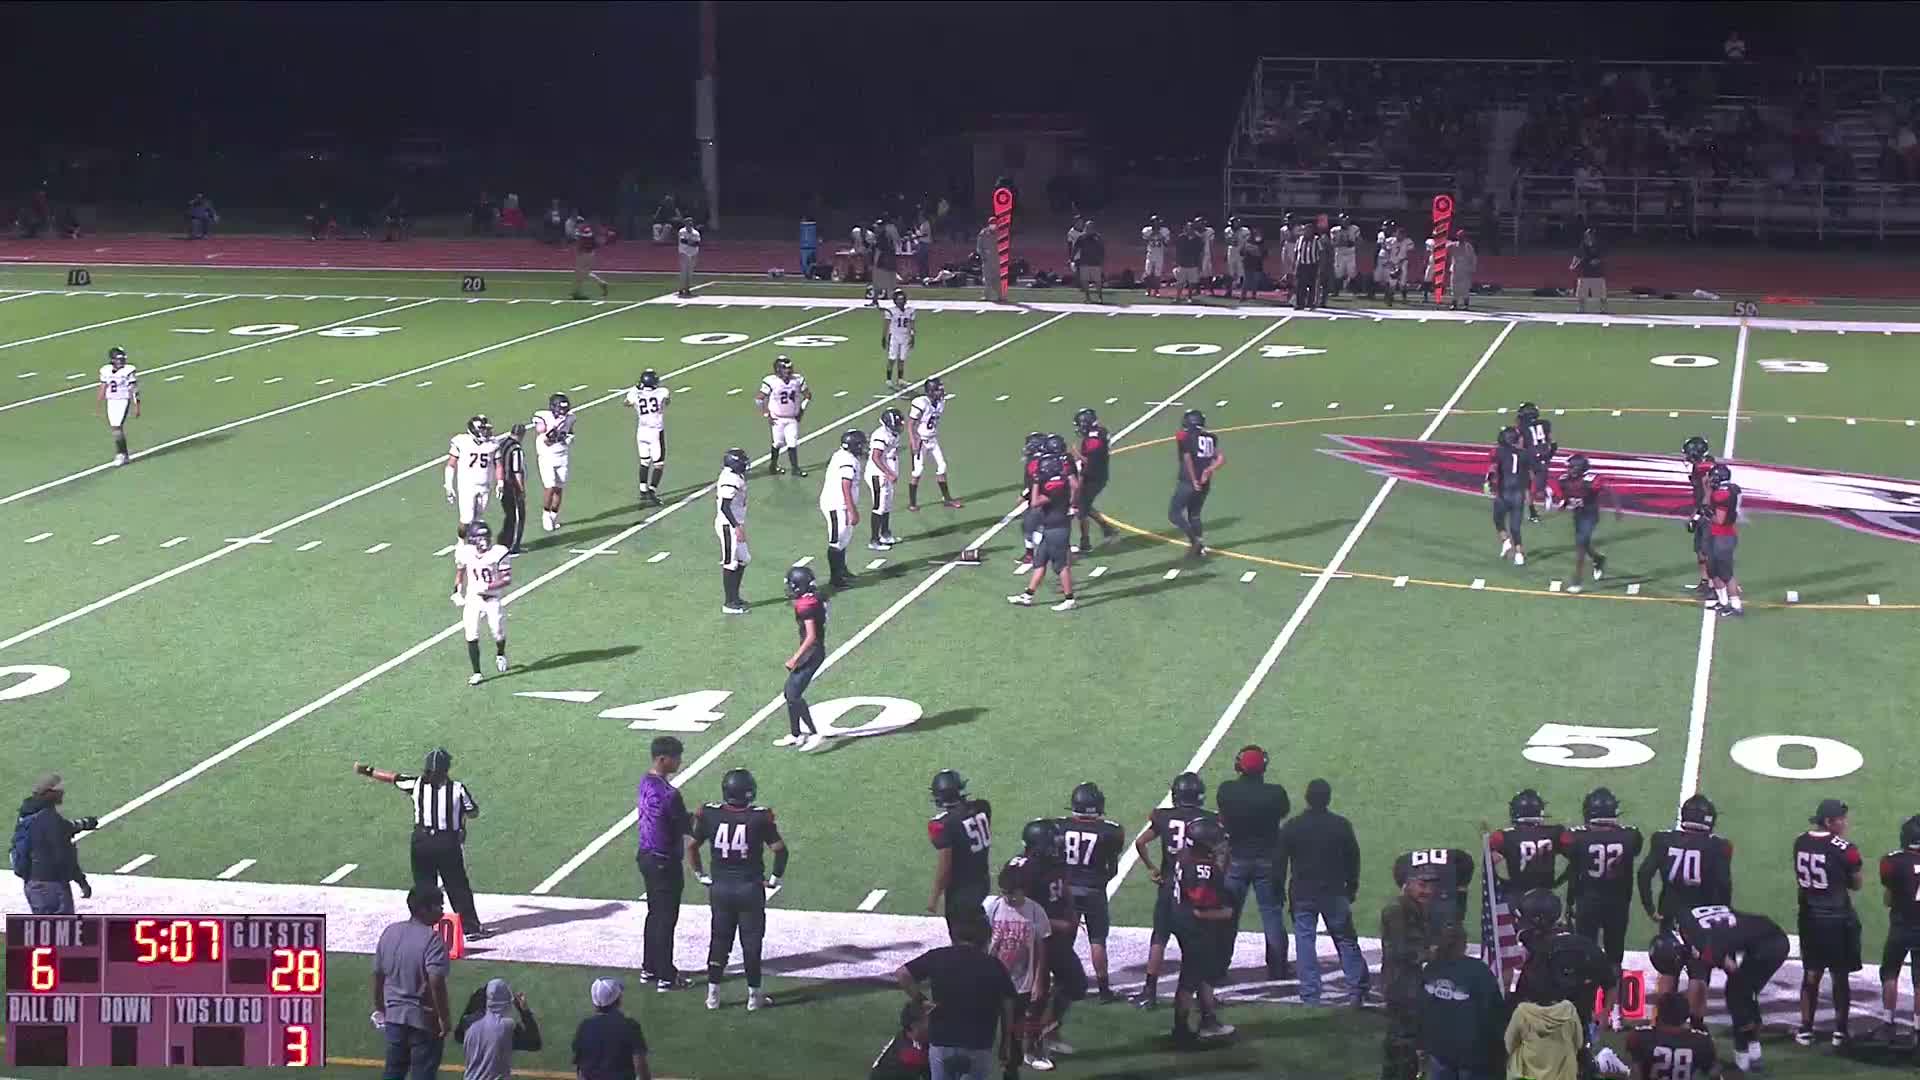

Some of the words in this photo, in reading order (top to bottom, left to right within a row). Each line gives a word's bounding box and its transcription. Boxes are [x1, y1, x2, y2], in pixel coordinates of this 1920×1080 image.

[71, 271, 88, 284] 10
[464, 278, 482, 290] 20
[638, 397, 659, 415] 23
[780, 390, 796, 405] 24
[1197, 435, 1214, 457] 90
[1528, 424, 1546, 446] 14
[469, 452, 489, 469] 75
[1511, 453, 1518, 474] 1
[473, 567, 492, 583] 10
[714, 822, 749, 858] 44
[961, 811, 992, 853] 50
[1064, 830, 1098, 865] 87
[1667, 846, 1702, 887] 70
[1796, 850, 1829, 890] 55
[1651, 1045, 1693, 1080] 28
